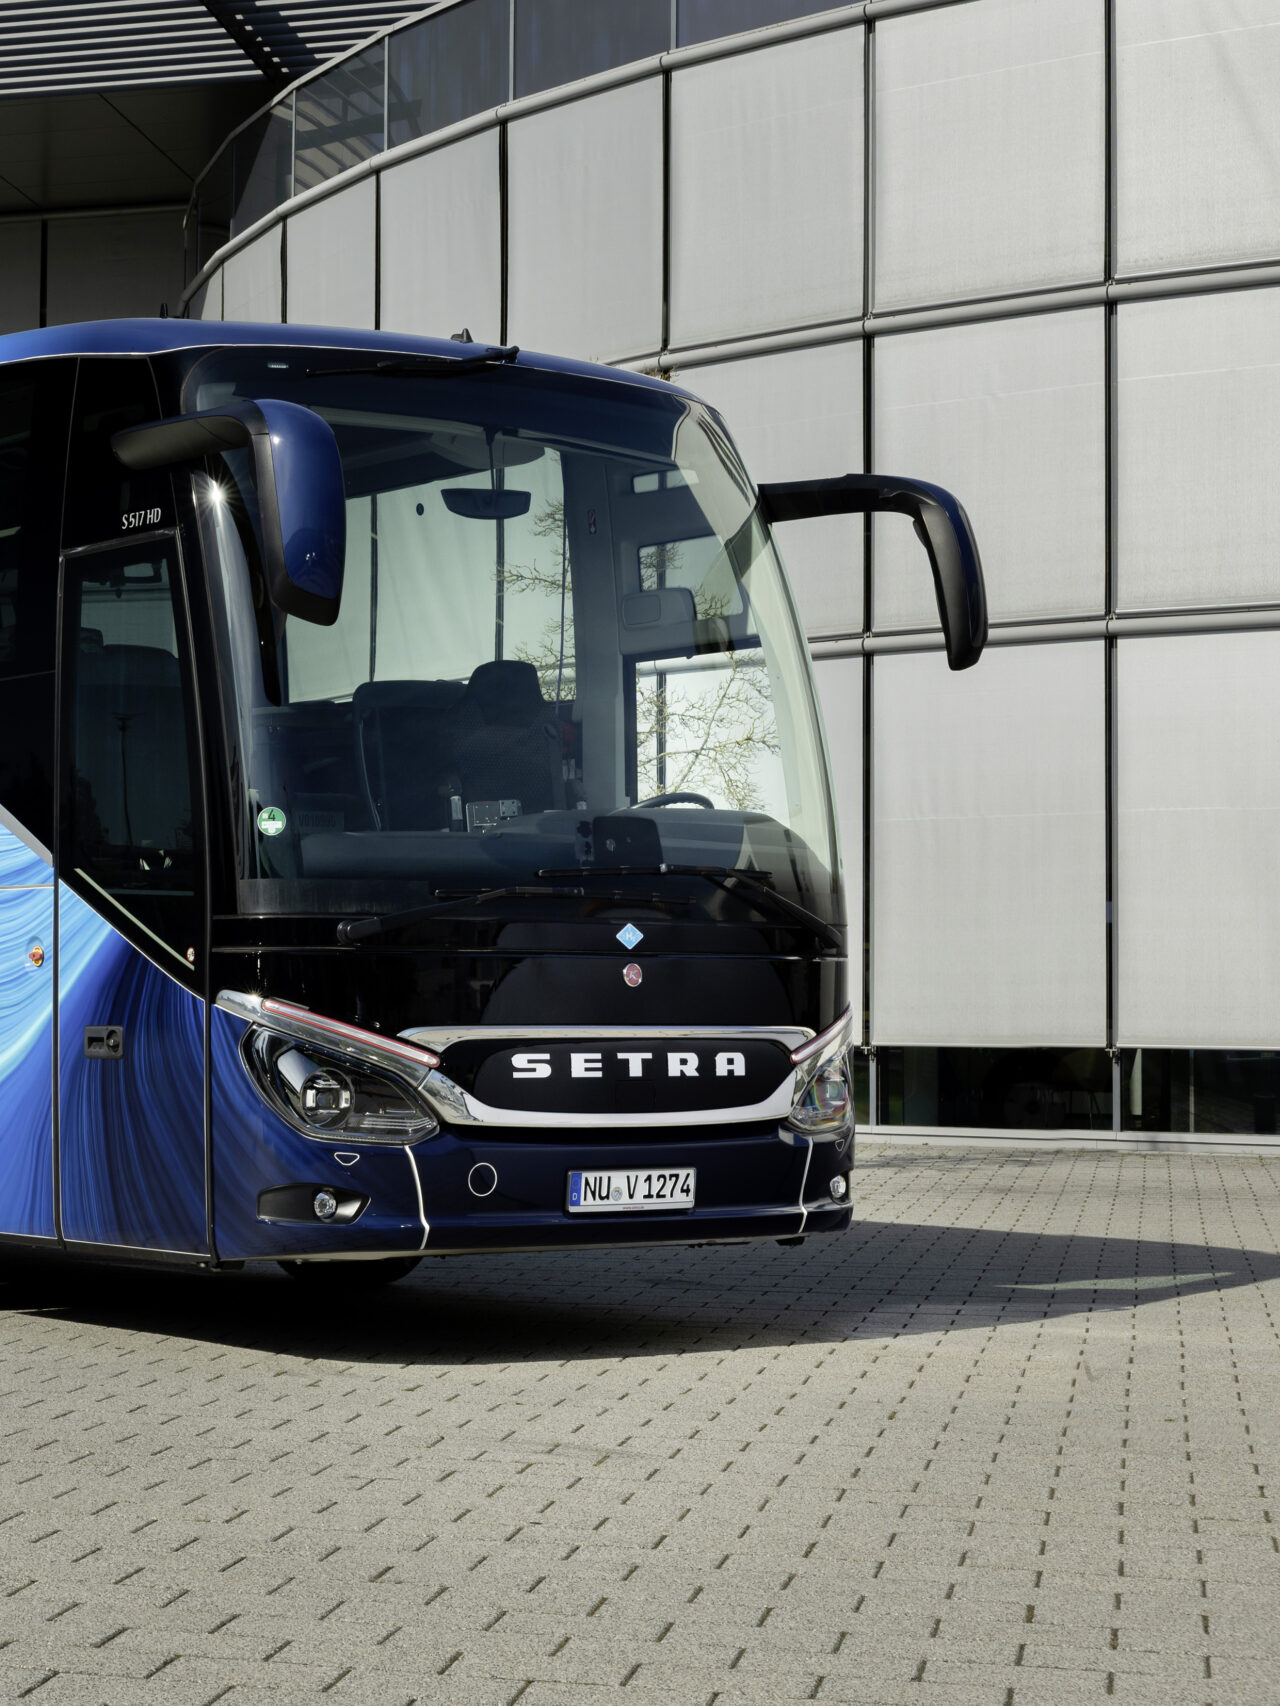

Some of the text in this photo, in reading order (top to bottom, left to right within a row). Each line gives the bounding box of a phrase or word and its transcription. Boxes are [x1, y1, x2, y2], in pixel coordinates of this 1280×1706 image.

[121, 507, 162, 530] S 517 HD
[267, 808, 276, 821] 4
[511, 1051, 746, 1079] SETRA
[572, 1172, 691, 1202] D NU V 1274
